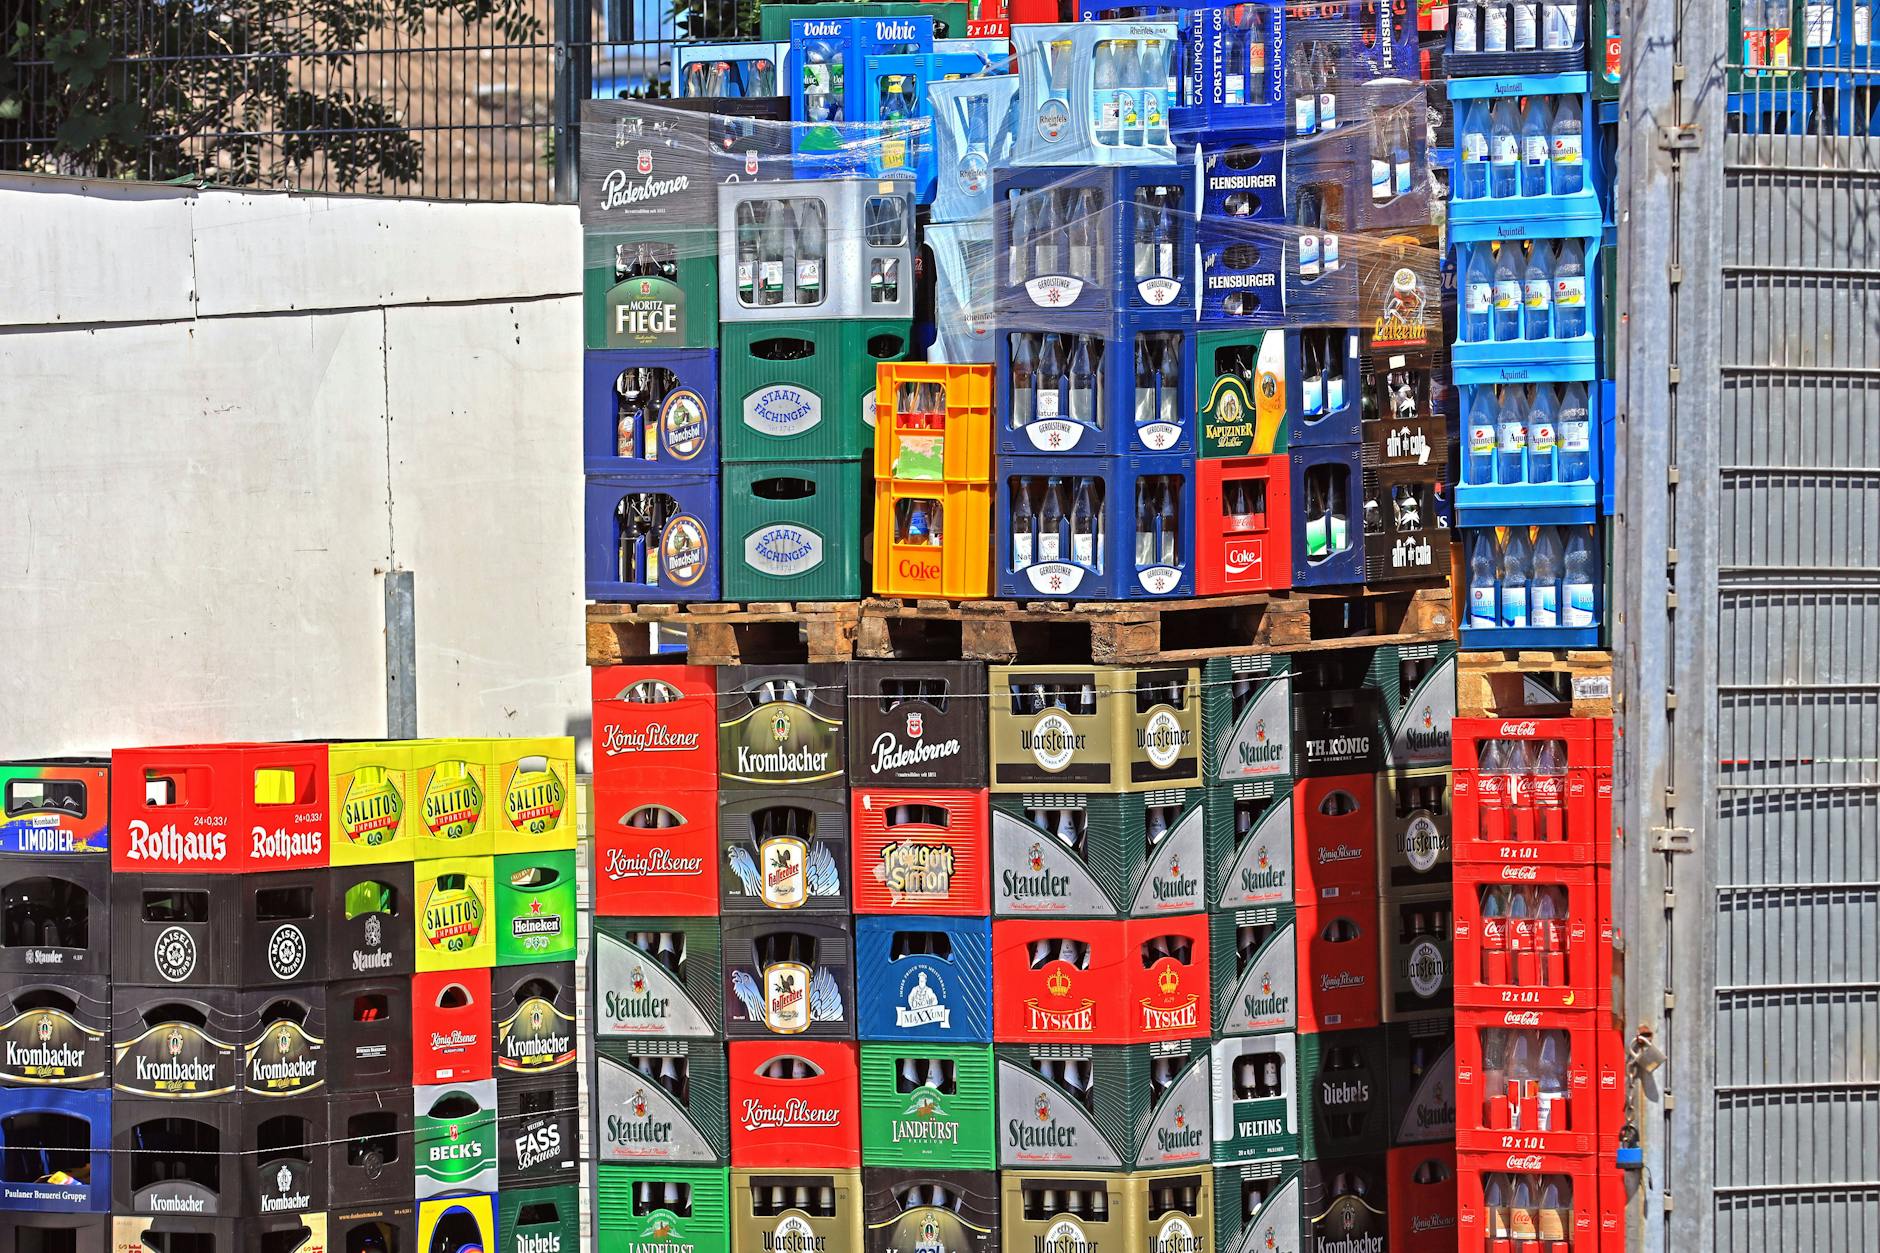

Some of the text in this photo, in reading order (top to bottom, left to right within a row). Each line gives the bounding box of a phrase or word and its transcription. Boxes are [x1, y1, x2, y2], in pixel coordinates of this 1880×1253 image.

[804, 22, 841, 36] Volvic
[876, 21, 916, 41] Volvic
[998, 24, 1003, 35] L
[1195, 10, 1203, 105] CALCIUMQUELLE
[1274, 7, 1282, 101] CALCIUMQUELLE
[1214, 33, 1222, 104] FORSTETAL
[601, 169, 689, 211] Paderborner
[1210, 175, 1276, 190] FLENSBURGER
[1038, 280, 1070, 289] GEROLSTEINER
[1147, 282, 1172, 290] GEROLSTEINER
[1209, 274, 1275, 289] FLENSBURGER
[630, 301, 663, 311] MORITZ
[616, 304, 676, 334] FIEGE
[1373, 317, 1425, 341] Leikeim
[762, 390, 801, 406] STAATL.
[754, 402, 811, 423] FACHINGEN
[1039, 422, 1071, 433] GEROLSTEINER
[1147, 425, 1172, 435] GEROLSTEINER
[1206, 423, 1254, 439] KAPUZINER
[1387, 429, 1401, 457] afri
[763, 530, 802, 546] STAATL.
[755, 543, 813, 563] FACHINGEN
[1230, 550, 1255, 564] Coke
[1392, 537, 1432, 567] afri cola
[900, 559, 940, 579] Coke
[1040, 567, 1071, 577] GEROLSTEINER
[1147, 569, 1172, 579] GEROLSTEINER
[602, 722, 699, 750] König Pilsener
[1137, 728, 1190, 749] Warsteiner
[1500, 722, 1536, 736] Coca-Cola
[1022, 730, 1086, 752] Warsteiner
[738, 746, 828, 773] Krombacher
[871, 732, 960, 774] Paderborner
[1239, 742, 1282, 765] Stauder
[427, 786, 478, 818] SALITOS
[510, 782, 560, 812] SALITOS
[346, 793, 398, 825] SALITOS
[436, 810, 472, 824] IMPORTED
[518, 805, 554, 819] IMPORTED
[355, 817, 391, 832] IMPORTED
[19, 829, 74, 851] LIMOBIER
[127, 820, 227, 865] Rothaus
[250, 826, 322, 862] Rothaus
[1397, 833, 1449, 854] Warsteiner
[605, 847, 702, 876] König Pilsener
[1501, 848, 1538, 858] 12 x 1.0 L
[1242, 868, 1285, 894] Stauder
[1502, 865, 1536, 880] Coca-Cola
[1003, 870, 1067, 900] Stauder
[1153, 876, 1198, 900] Stauder
[427, 900, 478, 930] SALITOS
[436, 924, 472, 938] IMPORTED
[515, 920, 559, 933] Heineken
[158, 932, 190, 956] MAISEL
[272, 930, 300, 955] MAISEL
[34, 949, 63, 965] Stauder
[168, 956, 192, 977] FRIENDS
[280, 952, 302, 974] FRIENDS
[353, 949, 392, 971] Stauder
[605, 991, 668, 1021] Stauder
[1245, 993, 1288, 1017] Stauder
[1502, 992, 1539, 1002] 12 x 1.0 L
[1029, 1007, 1093, 1030] TYSKIE
[1144, 1003, 1196, 1029] TYSKIE
[1504, 1011, 1540, 1026] Coca-Cola
[431, 1030, 477, 1048] König Pilsener
[507, 1032, 570, 1058] Krombacher
[6, 1041, 85, 1067] Krombacher
[136, 1056, 215, 1081] Krombacher
[253, 1058, 317, 1081] Krombacher
[1323, 1081, 1369, 1105] Diebels
[741, 1098, 840, 1126] König Pilsener
[1417, 1105, 1455, 1126] Staude
[527, 1120, 544, 1132] VELTINS
[608, 1114, 671, 1145] Stauder
[892, 1118, 959, 1145] LANDFÜRST
[1009, 1119, 1075, 1150] Stauder
[1239, 1119, 1282, 1138] VELTINS
[515, 1124, 561, 1161] FASS
[1158, 1126, 1201, 1151] Stauder
[1502, 1136, 1545, 1149] 12 x 1.0 L
[430, 1140, 482, 1161] BECK'S
[518, 1146, 561, 1171] Brause
[1506, 1156, 1542, 1170] Coca-Cola
[5, 1189, 87, 1203] Paulaner Brauerei Gruppe
[150, 1194, 204, 1212] Krombacher
[261, 1193, 310, 1212] Krombacher
[516, 1232, 560, 1253] Diebels
[762, 1231, 826, 1252] Warsteiner
[1034, 1235, 1098, 1253] Warsteiner
[1149, 1235, 1203, 1253] Warsteiner
[1317, 1232, 1384, 1253] Krombacher
